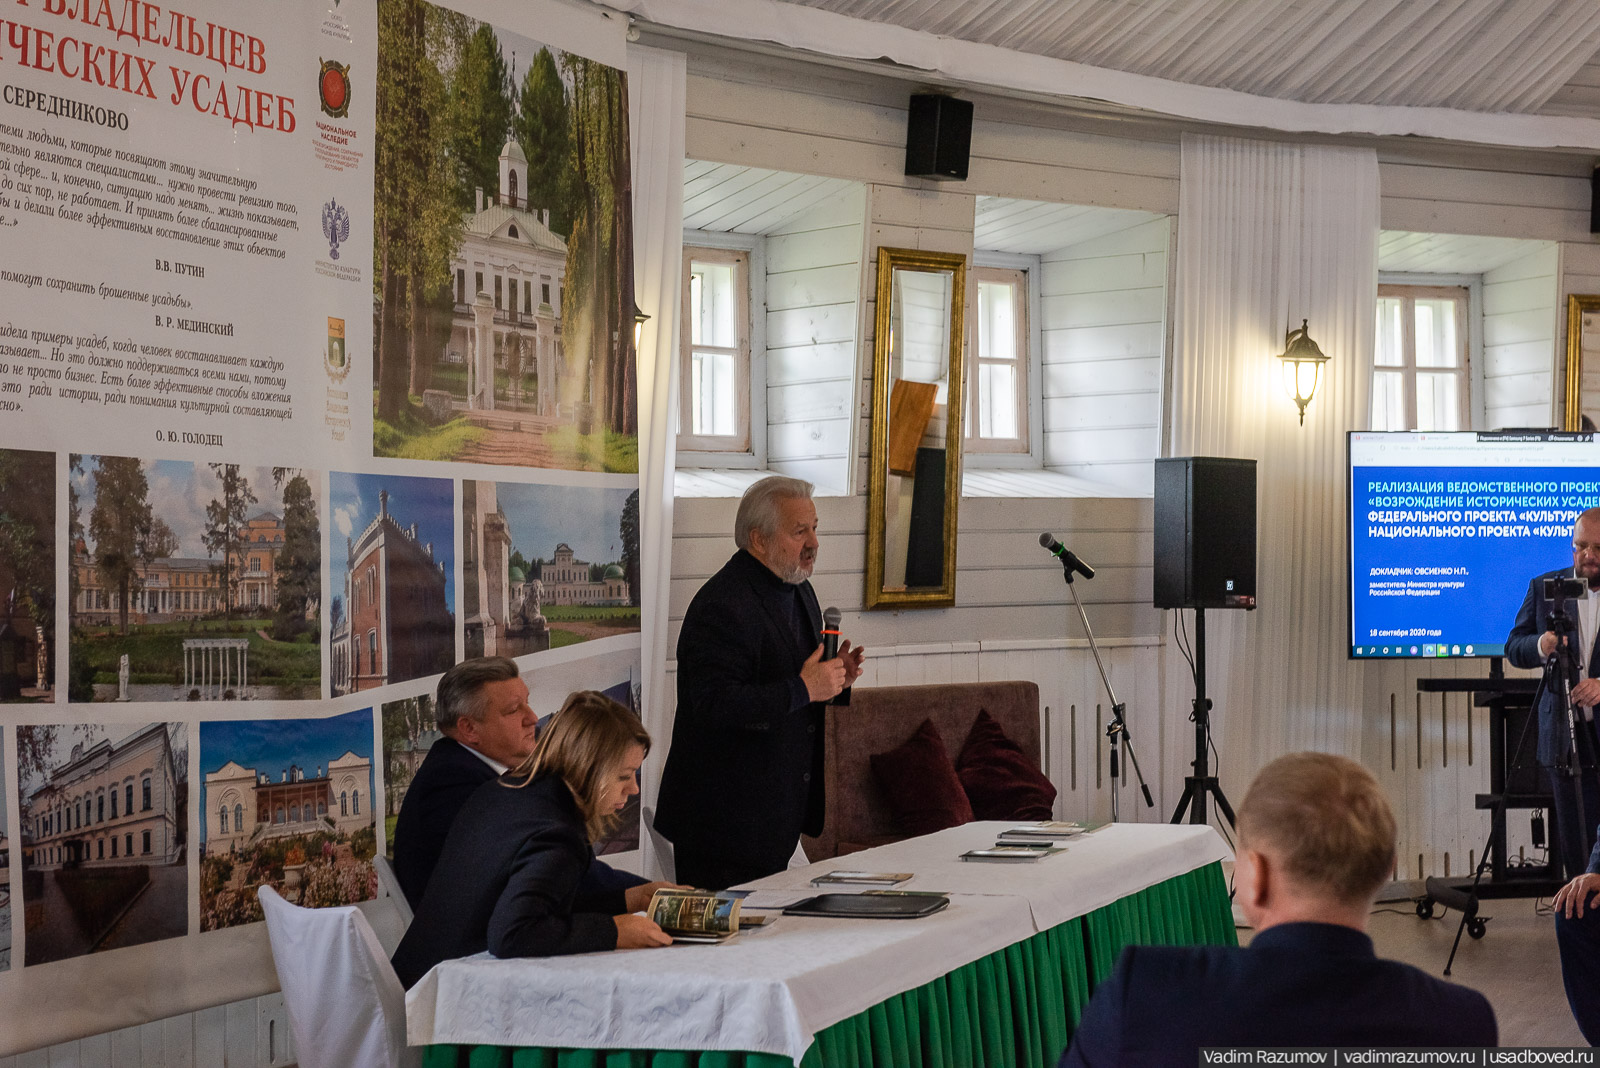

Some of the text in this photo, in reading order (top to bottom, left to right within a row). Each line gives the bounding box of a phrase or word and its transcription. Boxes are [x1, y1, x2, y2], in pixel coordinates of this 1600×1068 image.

[0, 19, 296, 133] ЧЕСКИХ УСАДЕБ
[3, 84, 129, 131] СЕРЕДНИКОВО
[320, 132, 348, 146] НАСЛЕДИЕ
[0, 124, 258, 192] теми людьми, которые посвящают этому значительную
[0, 142, 298, 216] тельно являются специалистами... нужно провести ревизию того,
[1, 174, 278, 242] до сих пор, не работает. И принять более сбалансированные
[13, 160, 48, 180] сфере...
[51, 171, 60, 185] и,
[63, 173, 104, 193] конечно,
[106, 182, 153, 202] ситуацию
[155, 190, 176, 206] надо
[178, 197, 215, 215] менять...
[218, 206, 245, 220] жизнь
[246, 212, 300, 232] показывает,
[14, 198, 20, 210] и
[24, 196, 55, 217] делали
[58, 204, 84, 222] более
[86, 211, 153, 235] эффективным
[156, 226, 220, 248] восстановление
[222, 240, 244, 252] этих
[246, 241, 286, 260] объектов
[155, 258, 206, 279] В.В. ПУТИН
[1, 270, 193, 310] помогут сохранить брошенные усадьбы».
[155, 314, 234, 337] В. Р. МЕДИНСКИЙ
[31, 330, 74, 348] примеры
[76, 333, 110, 352] усадеб,
[112, 338, 138, 354] когда
[140, 344, 172, 358] человек
[174, 348, 248, 367] восстанавливает
[250, 356, 285, 374] каждую
[50, 346, 65, 362] Но
[67, 353, 85, 366] это
[88, 350, 124, 369] должно
[126, 356, 200, 378] поддерживаться
[202, 368, 226, 381] всеми
[228, 371, 252, 386] нами,
[254, 374, 287, 390] потому
[12, 364, 24, 376] не
[27, 366, 62, 380] просто
[64, 366, 98, 384] бизнес.
[100, 370, 124, 387] Есть
[126, 373, 152, 389] более
[153, 377, 214, 396] эффективные
[216, 385, 249, 400] способы
[251, 390, 292, 404] вложения
[1, 380, 292, 422] это ради истории, ради понимания культурной составляющей
[156, 430, 224, 448] О. Ю. ГОЛОДЕЦ
[1368, 482, 1444, 494] РЕАЛИЗАЦИЯ
[1447, 481, 1558, 494] ВЕДОМСТВЕННОГО
[1368, 496, 1600, 509] «ВОЗРОЖДЕНИЕ ИСТОРИЧЕСКИХ УСАДЕ
[1368, 510, 1462, 524] ФЕДЕРАЛЬНОГО
[1464, 510, 1517, 522] ПРОЕКТА
[1368, 526, 1476, 540] НАЦИОНАЛЬНОГО
[1478, 525, 1531, 538] ПРОЕКТА
[1406, 580, 1438, 590] Министра
[1438, 582, 1465, 590] культуры
[1414, 567, 1453, 576] ОВСИЕНКО
[1369, 588, 1441, 598] Российской Федерации
[1370, 628, 1442, 638] 18 сентября 2020 года
